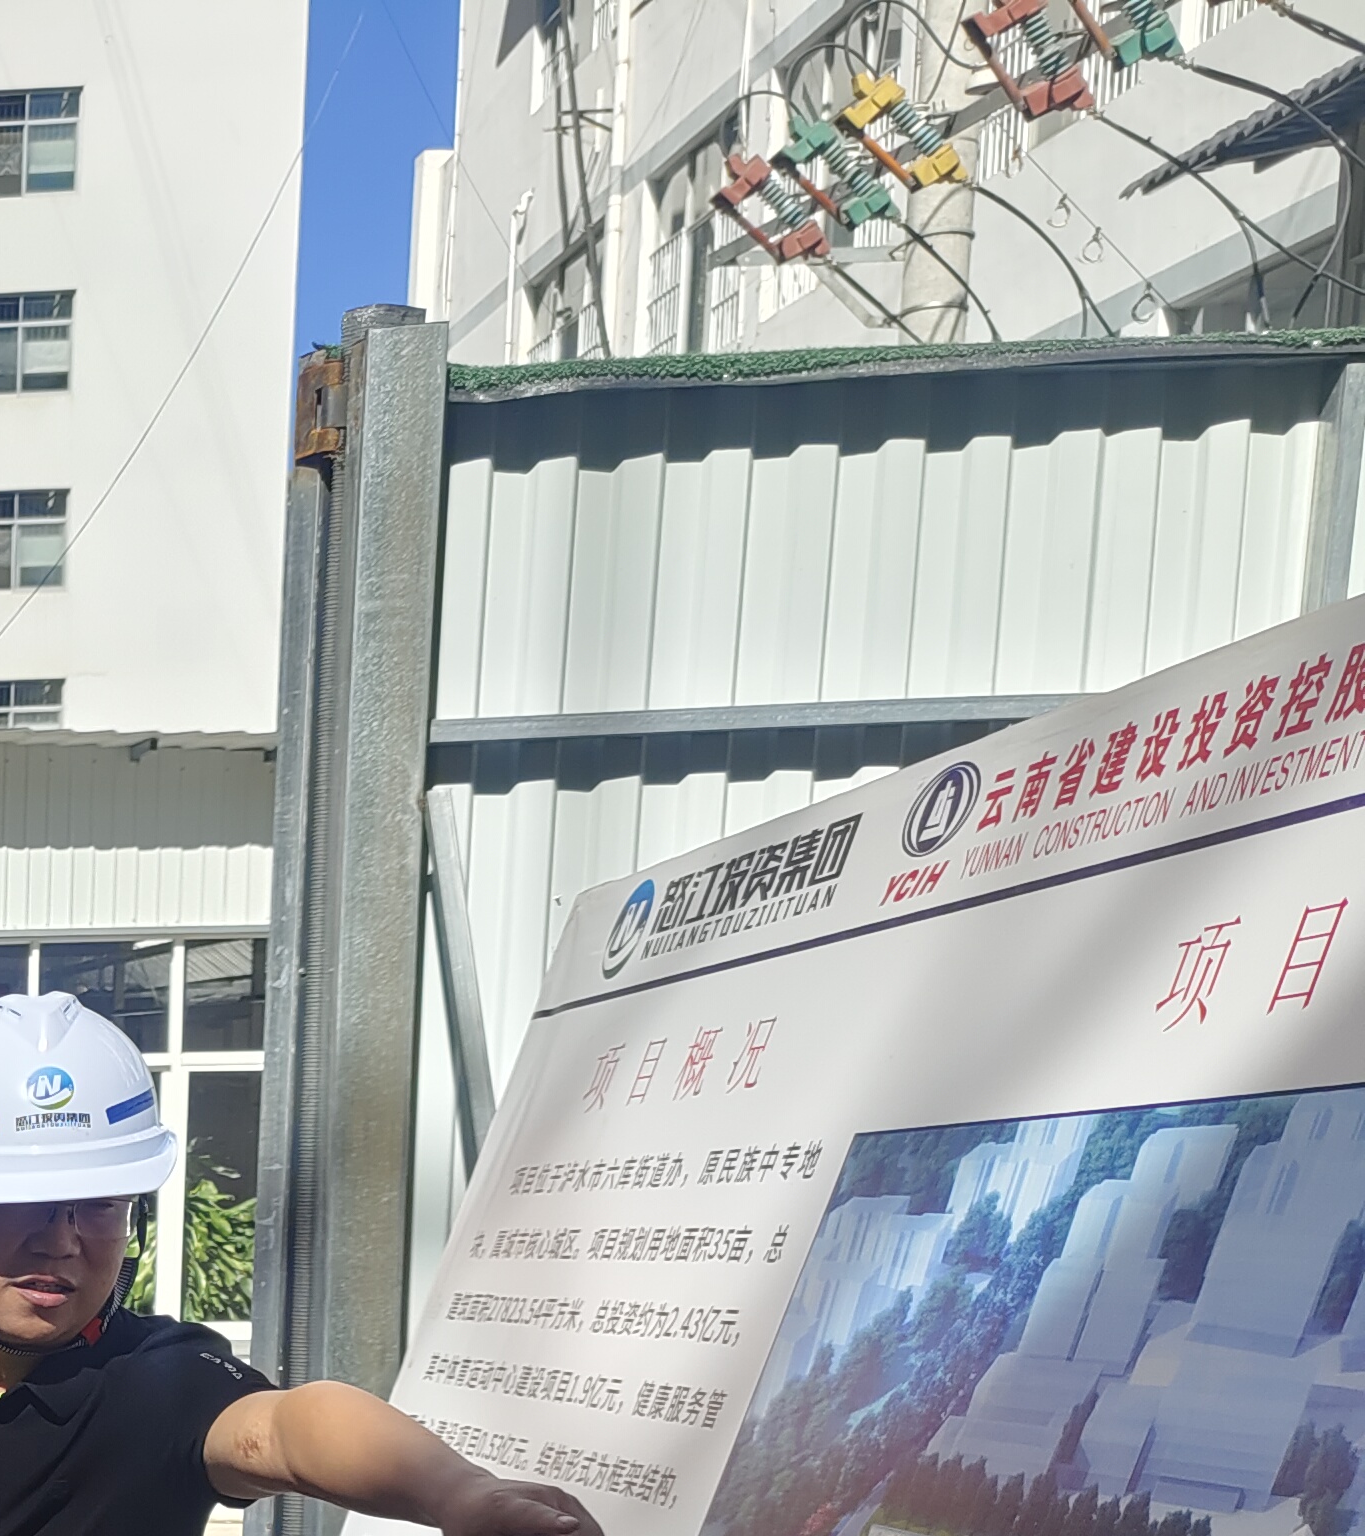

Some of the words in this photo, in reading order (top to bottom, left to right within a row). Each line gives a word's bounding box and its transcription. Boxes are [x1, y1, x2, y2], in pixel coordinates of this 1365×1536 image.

[649, 812, 864, 935] 怒江投资集团
[959, 830, 1028, 879] YUNNAN
[1032, 786, 1176, 860] CONSTRUCTION
[878, 859, 951, 908] YCIH
[1155, 897, 1349, 1033] 项目
[582, 1015, 778, 1114] 项目概况
